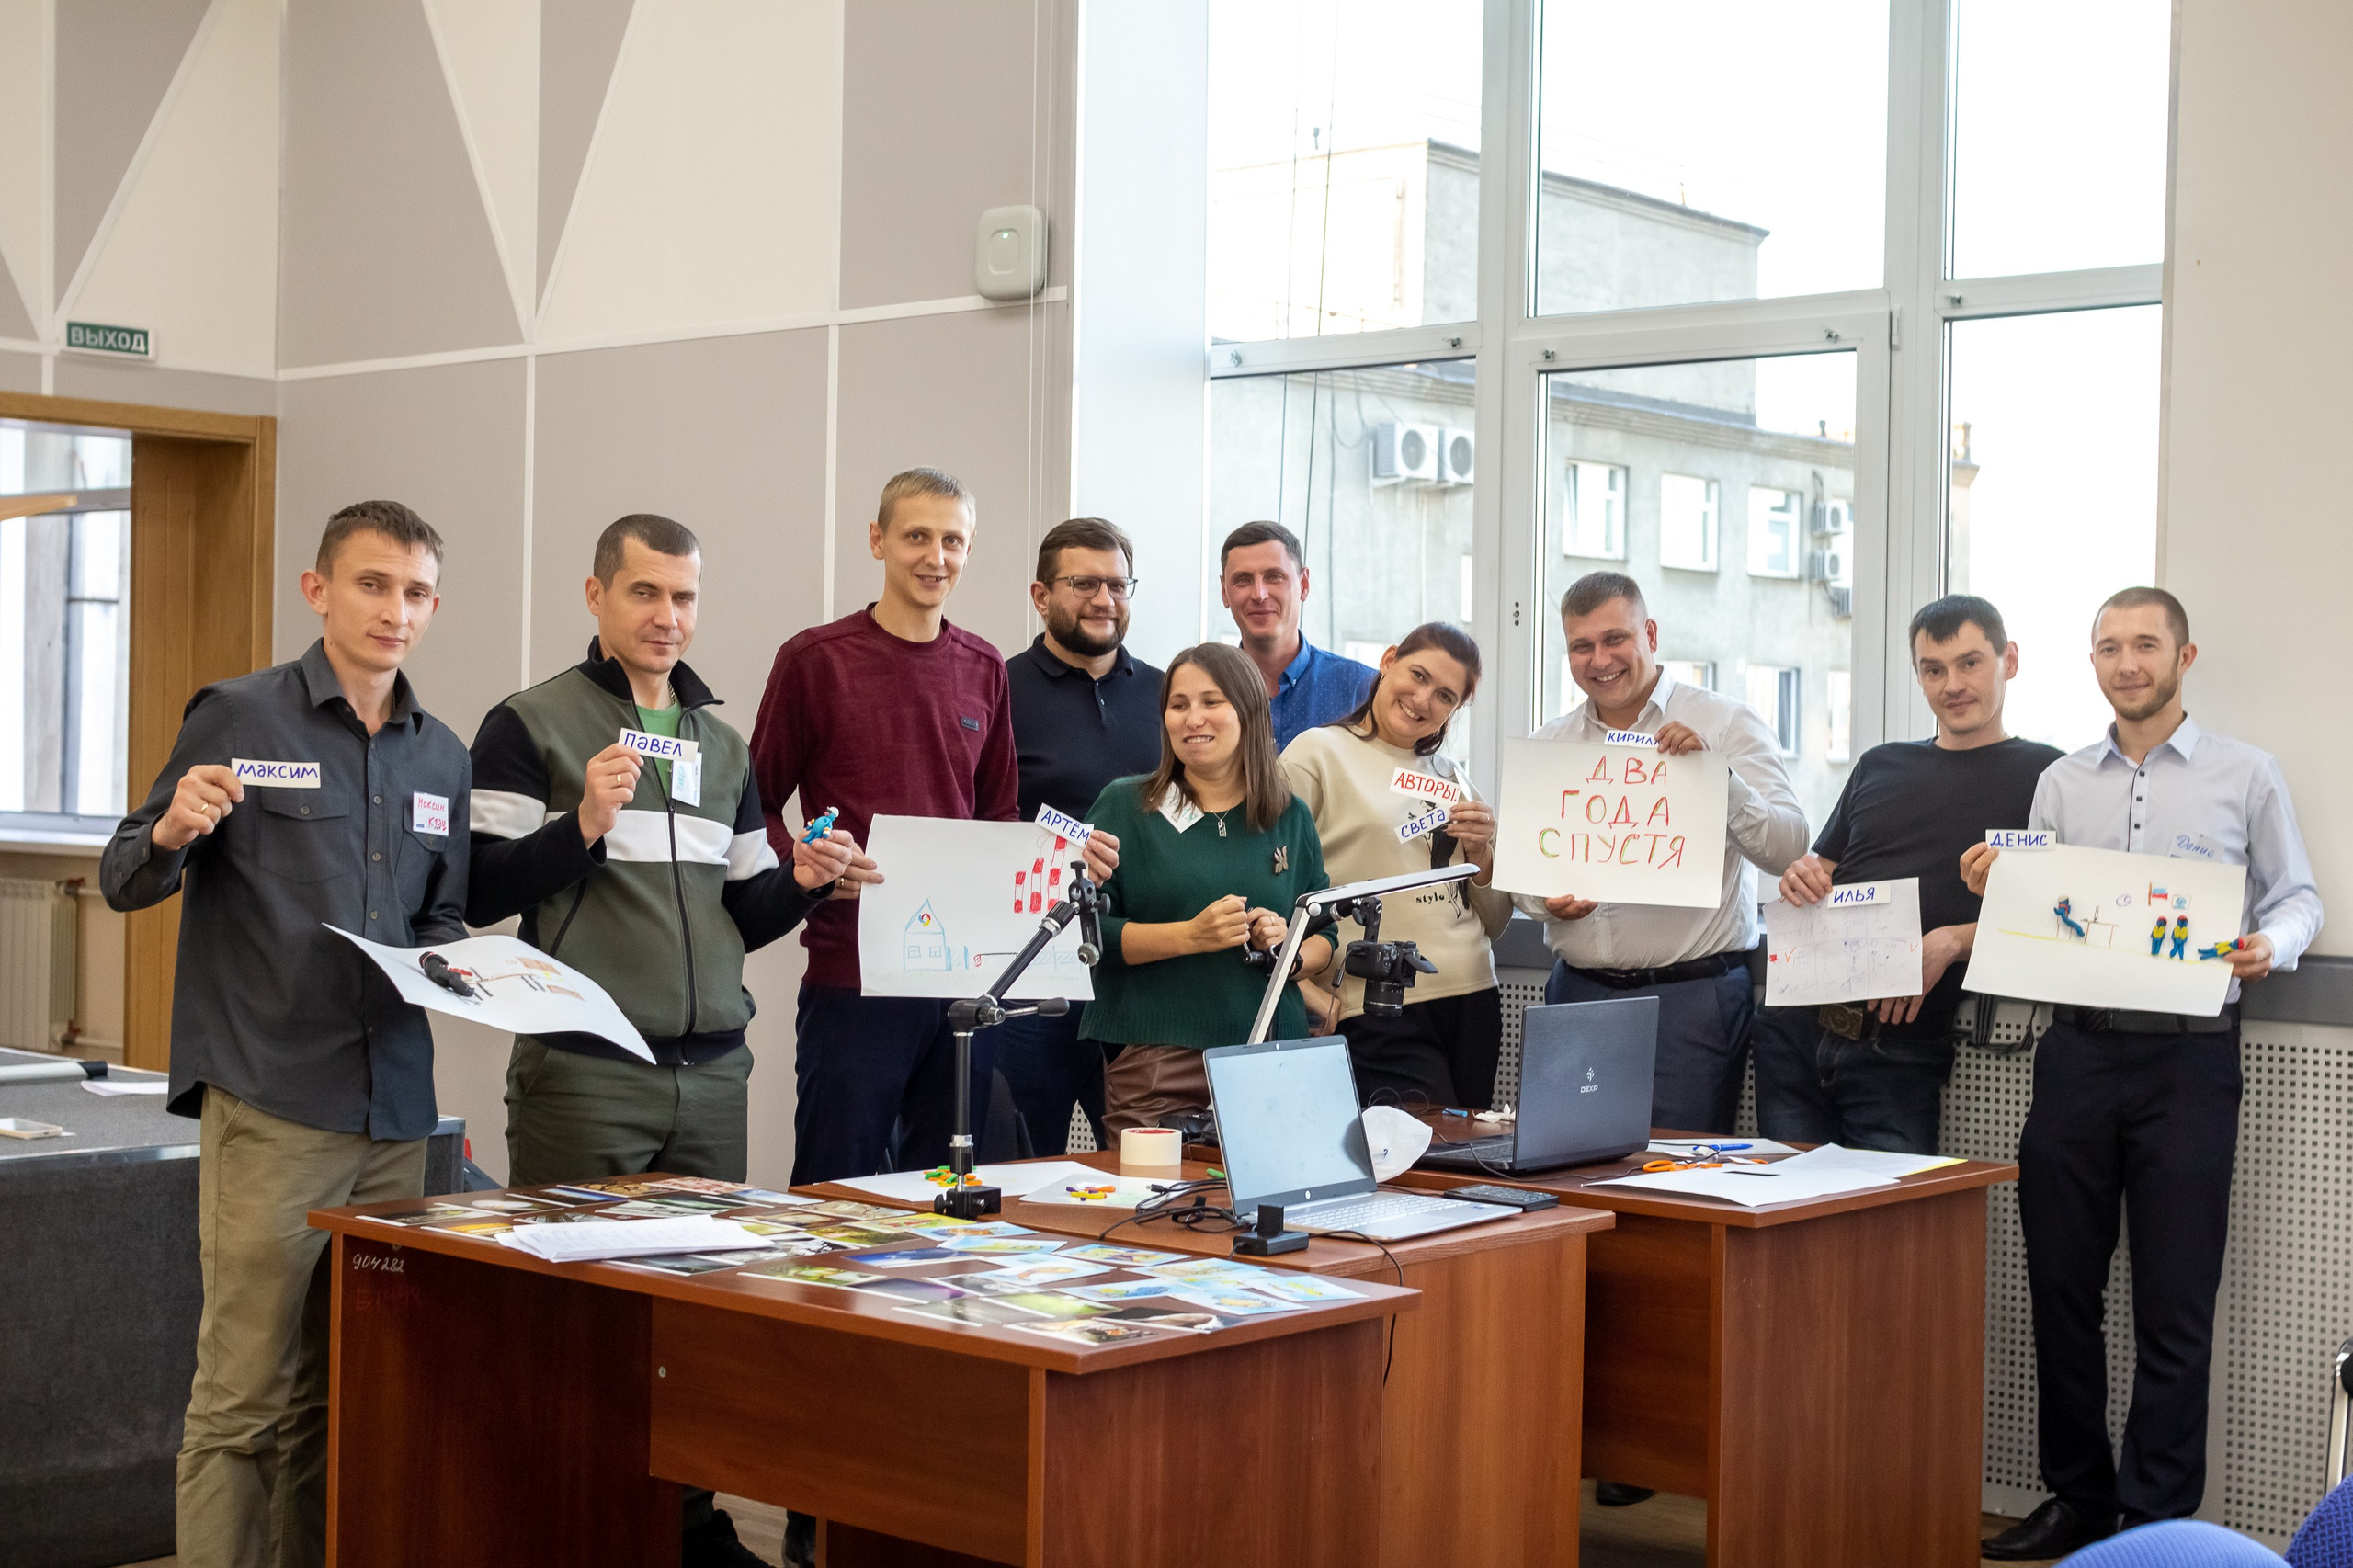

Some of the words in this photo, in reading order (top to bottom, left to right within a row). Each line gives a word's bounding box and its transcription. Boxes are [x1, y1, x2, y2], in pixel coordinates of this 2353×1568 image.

[70, 325, 146, 353] ВЫХОД
[1585, 756, 1667, 785] ДВА
[417, 797, 445, 812] Максим
[1561, 790, 1669, 829] ГОДА
[1040, 809, 1090, 845] АРТЁМ
[1538, 827, 1686, 869] СПУСТЯ
[1989, 831, 2048, 847] ДЕНИС
[2176, 835, 2215, 858] Денис
[1833, 886, 1875, 903] ИЛЬЯ
[1580, 1085, 1598, 1094] DEXP
[352, 1253, 404, 1273] 904282
